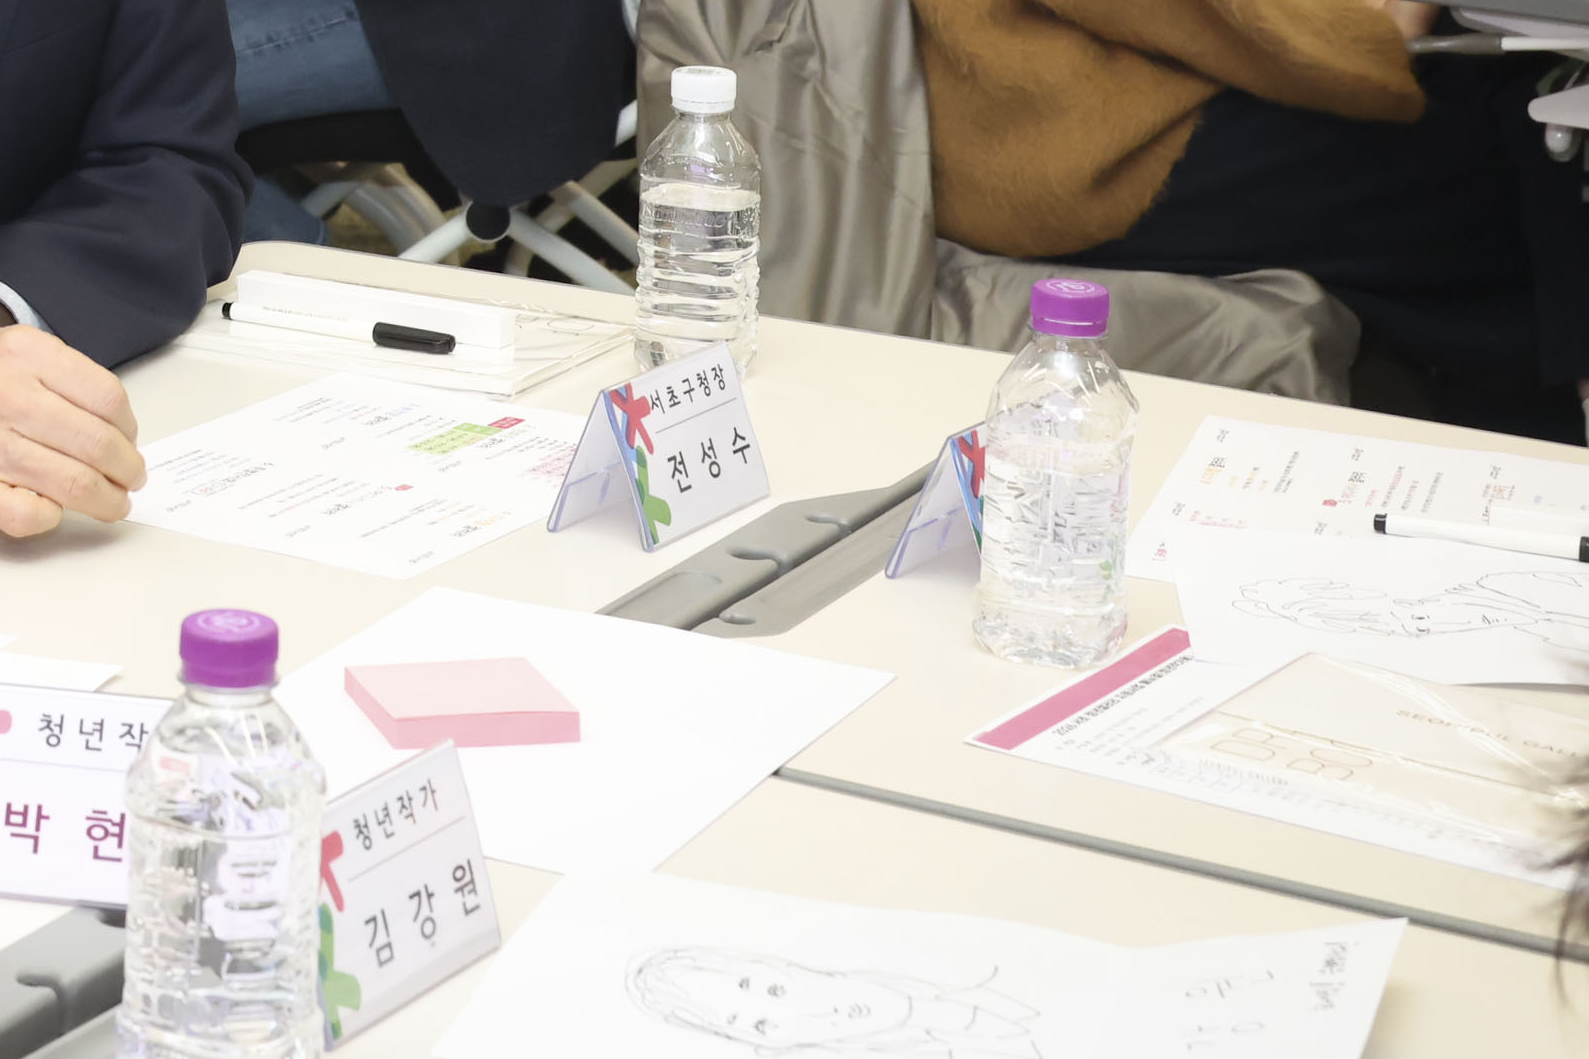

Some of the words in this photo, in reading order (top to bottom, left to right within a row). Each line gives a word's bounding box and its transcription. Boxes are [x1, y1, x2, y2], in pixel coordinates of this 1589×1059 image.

[649, 363, 726, 414] 서초구청장
[667, 426, 751, 494] 전성수
[38, 713, 149, 754] 청년작
[4, 802, 126, 863] 박현
[353, 778, 439, 851] 청년작가
[364, 858, 481, 968] 김강원
